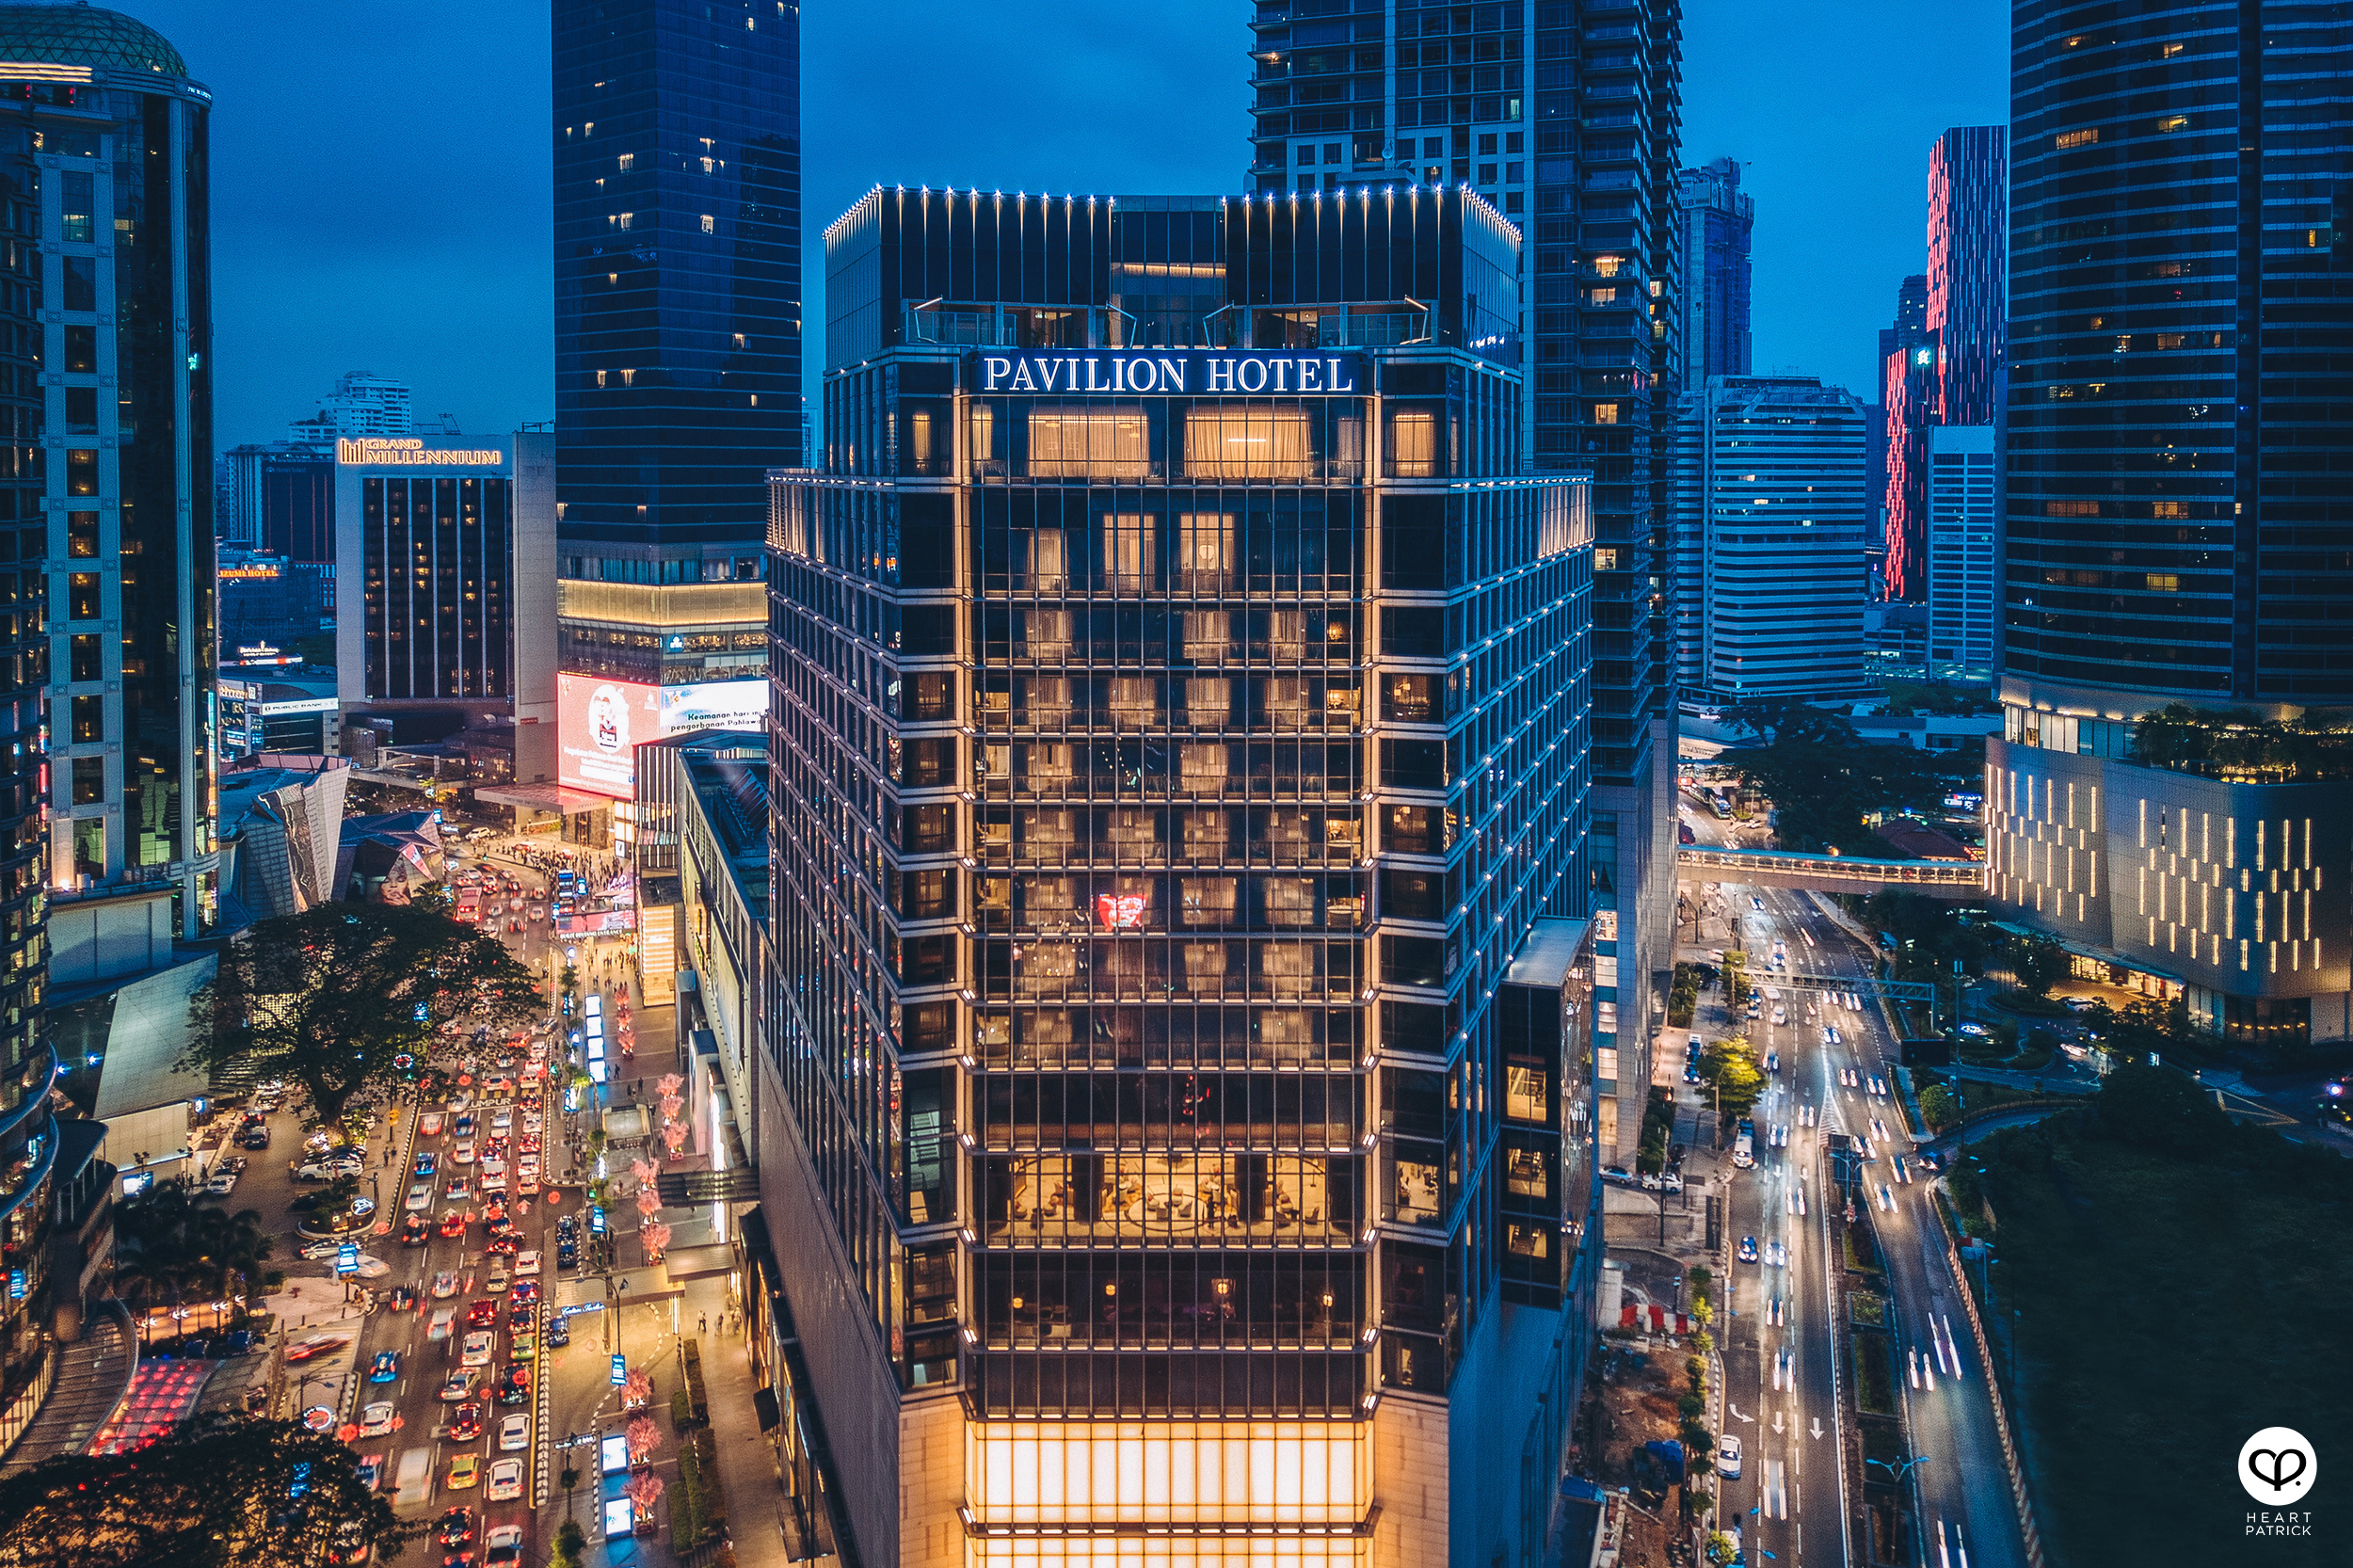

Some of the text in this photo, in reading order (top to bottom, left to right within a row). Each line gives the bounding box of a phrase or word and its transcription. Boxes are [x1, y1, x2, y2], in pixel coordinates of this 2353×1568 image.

[984, 358, 1353, 392] PAVILION HOTEL
[365, 439, 423, 450] GRAND
[366, 450, 502, 465] MILLENNIUM
[248, 569, 280, 578] HOTEL
[688, 712, 730, 721] Keamanan
[670, 721, 725, 732] pengorbanan
[467, 1097, 511, 1109] UMPUR
